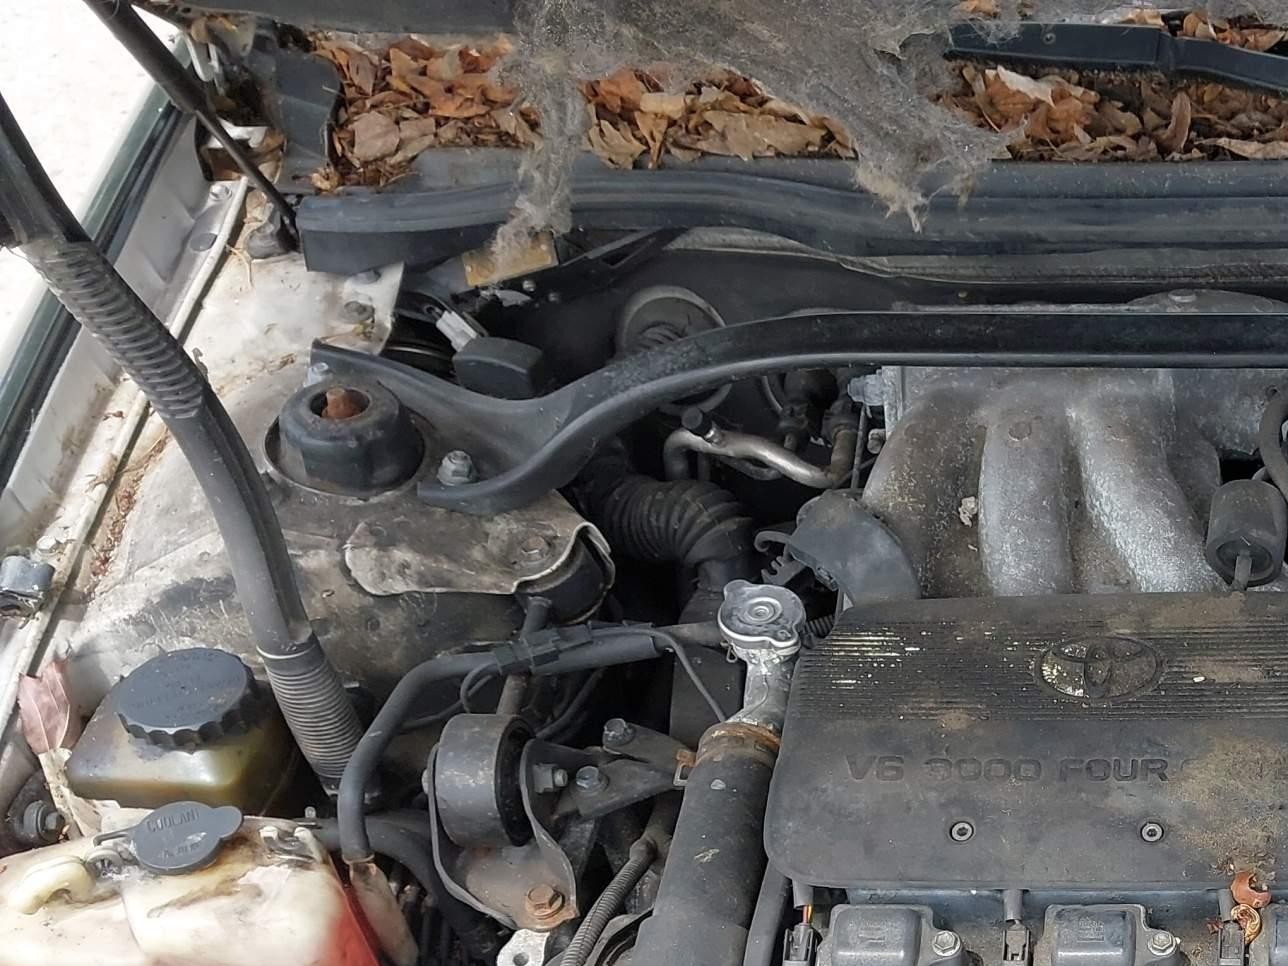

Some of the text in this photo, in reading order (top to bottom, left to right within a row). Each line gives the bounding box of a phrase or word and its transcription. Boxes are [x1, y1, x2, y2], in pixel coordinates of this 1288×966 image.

[844, 754, 904, 782] V6
[924, 757, 1043, 782] 3000
[1058, 758, 1169, 782] FOUR
